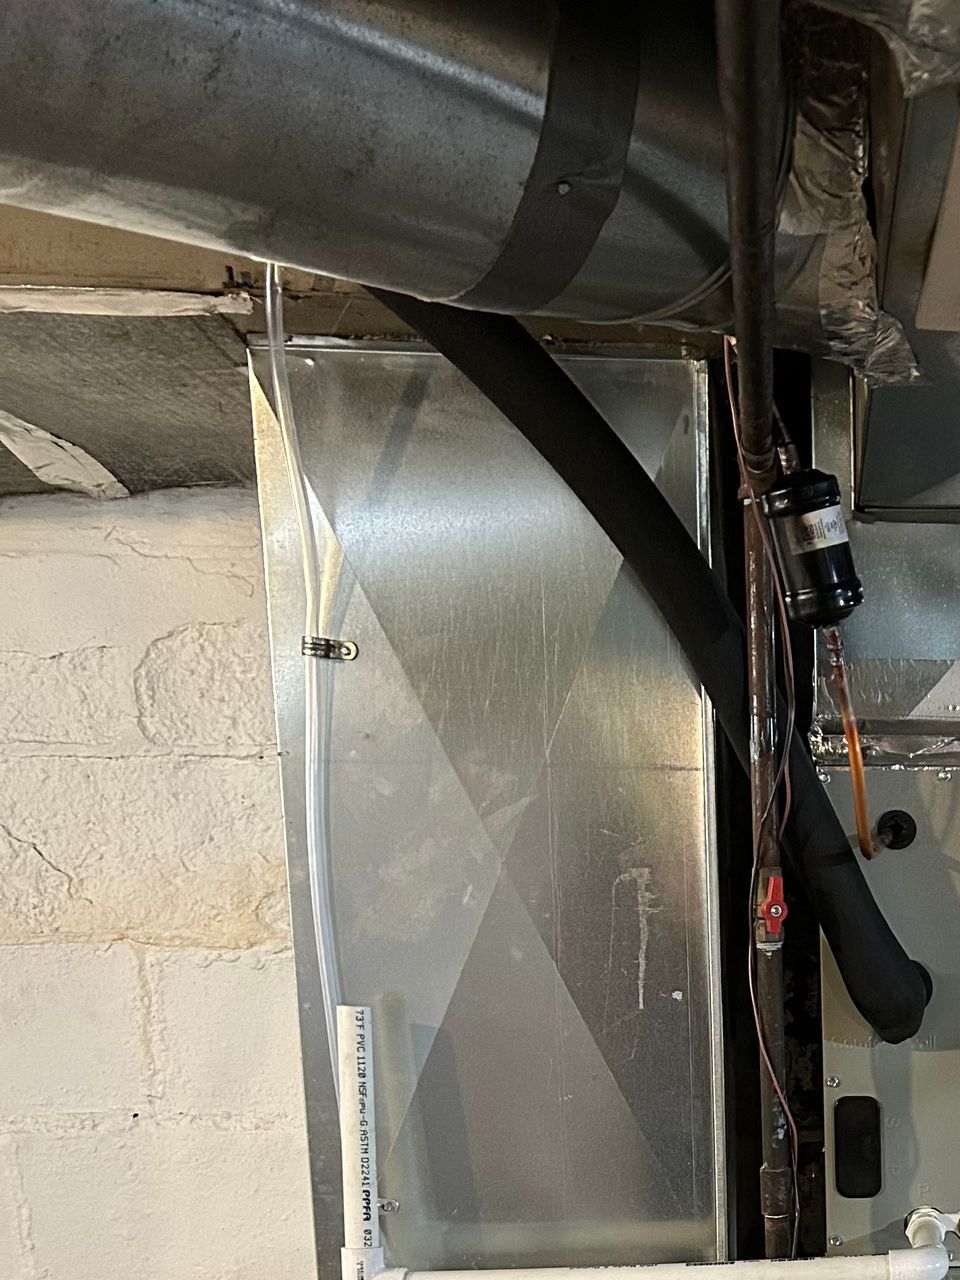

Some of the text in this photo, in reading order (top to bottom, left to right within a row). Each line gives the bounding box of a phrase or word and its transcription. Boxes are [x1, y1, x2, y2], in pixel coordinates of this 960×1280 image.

[356, 1033, 366, 1053] PVC
[357, 1056, 366, 1078] 1120
[360, 1129, 369, 1155] ASTM
[361, 1157, 370, 1186] D2241
[363, 1189, 372, 1221] PPFA
